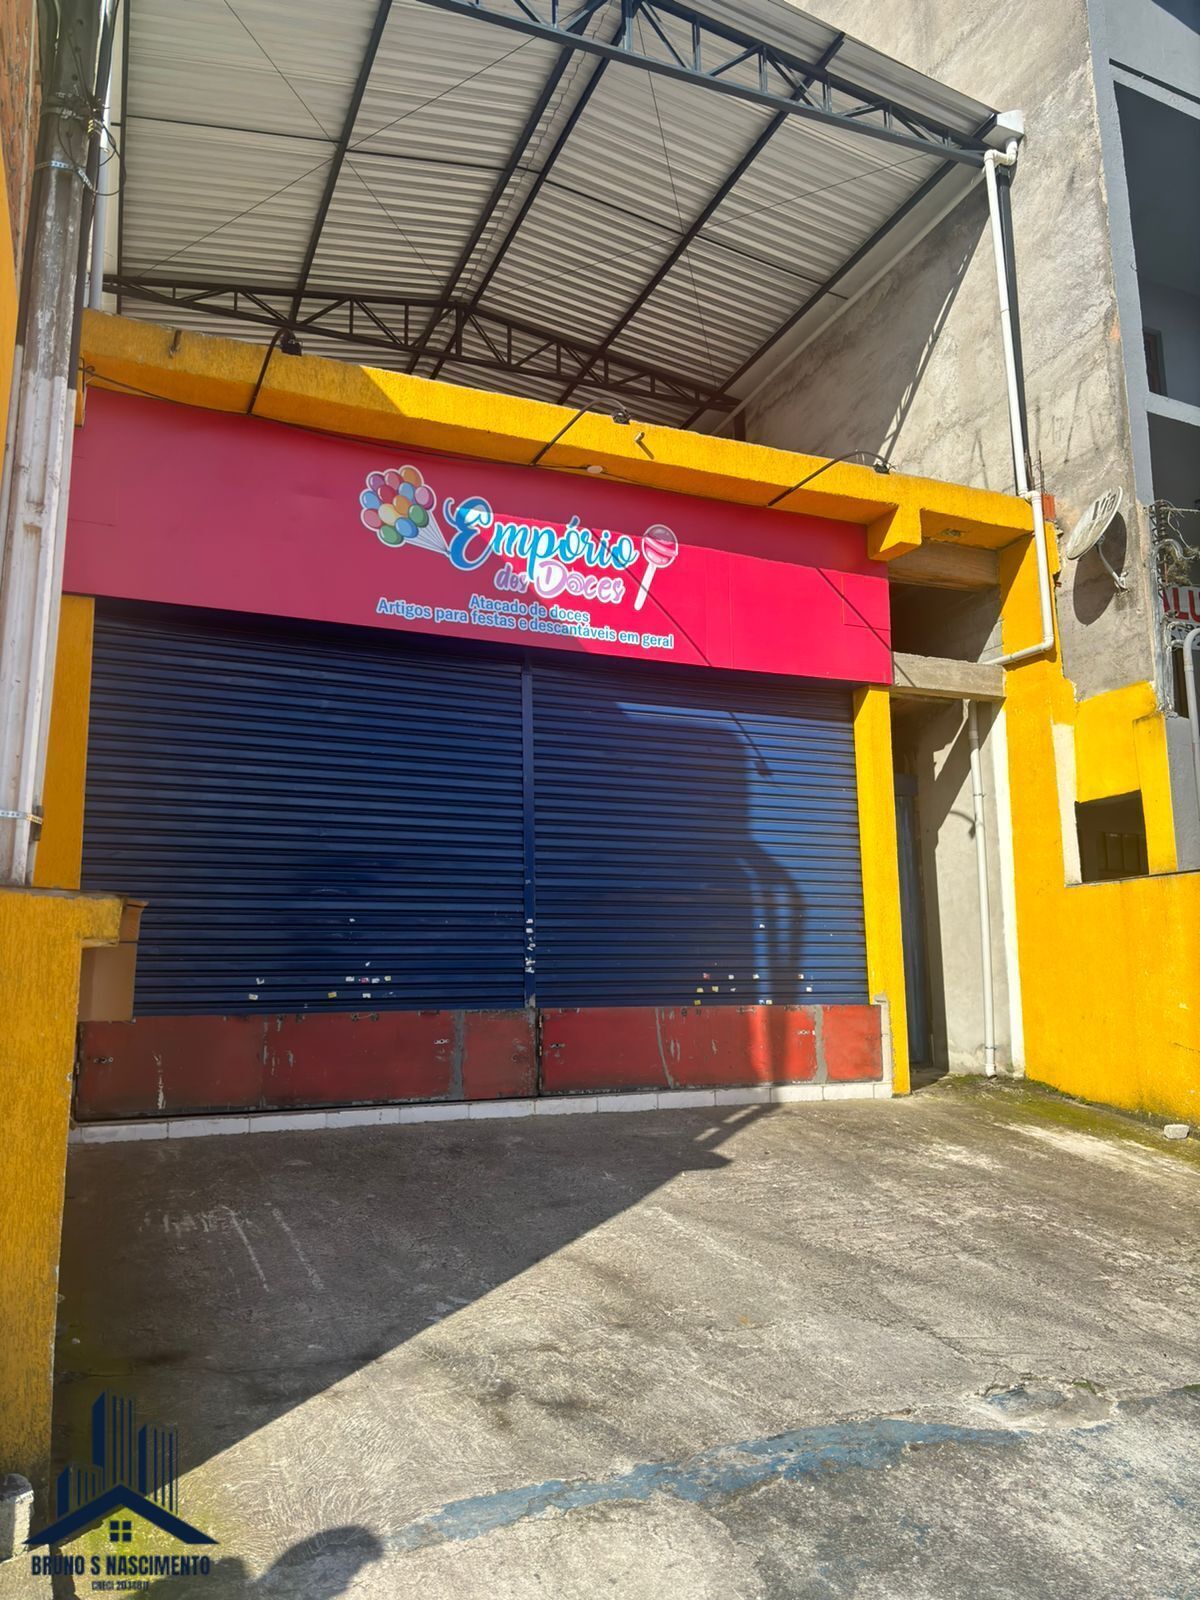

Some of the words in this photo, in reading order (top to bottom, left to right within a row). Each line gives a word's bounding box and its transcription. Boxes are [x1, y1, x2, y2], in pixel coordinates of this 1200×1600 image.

[444, 497, 639, 579] Empório
[494, 563, 529, 593] dos
[535, 560, 626, 604] Doces
[377, 597, 432, 619] Artigos
[435, 608, 468, 622] para
[471, 609, 516, 629] festas
[518, 619, 528, 630] e
[528, 617, 616, 640] descantáveis
[618, 630, 639, 644] em
[641, 634, 674, 649] geral
[469, 594, 527, 615] Atacado
[529, 601, 547, 617] de
[549, 604, 590, 623] doces
